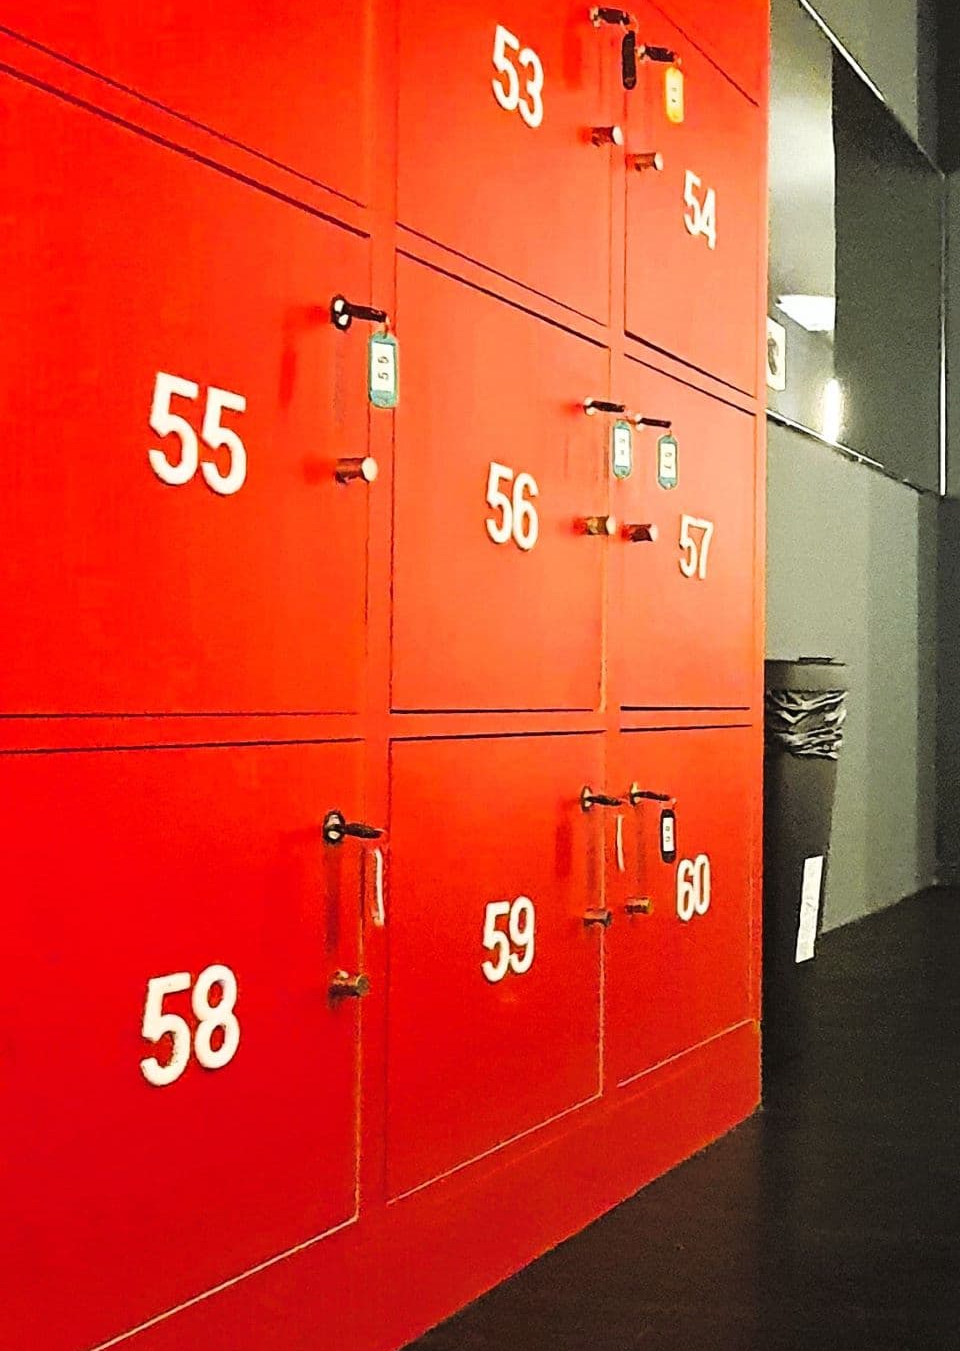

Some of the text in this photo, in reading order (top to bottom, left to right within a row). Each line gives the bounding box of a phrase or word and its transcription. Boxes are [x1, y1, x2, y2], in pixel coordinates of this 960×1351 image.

[492, 24, 544, 129] 53
[683, 169, 717, 250] 54
[147, 371, 248, 496] 55
[486, 461, 540, 552] 56
[678, 514, 714, 580] 57
[675, 853, 711, 923] 60
[482, 896, 536, 983] 59
[140, 963, 241, 1088] 58
